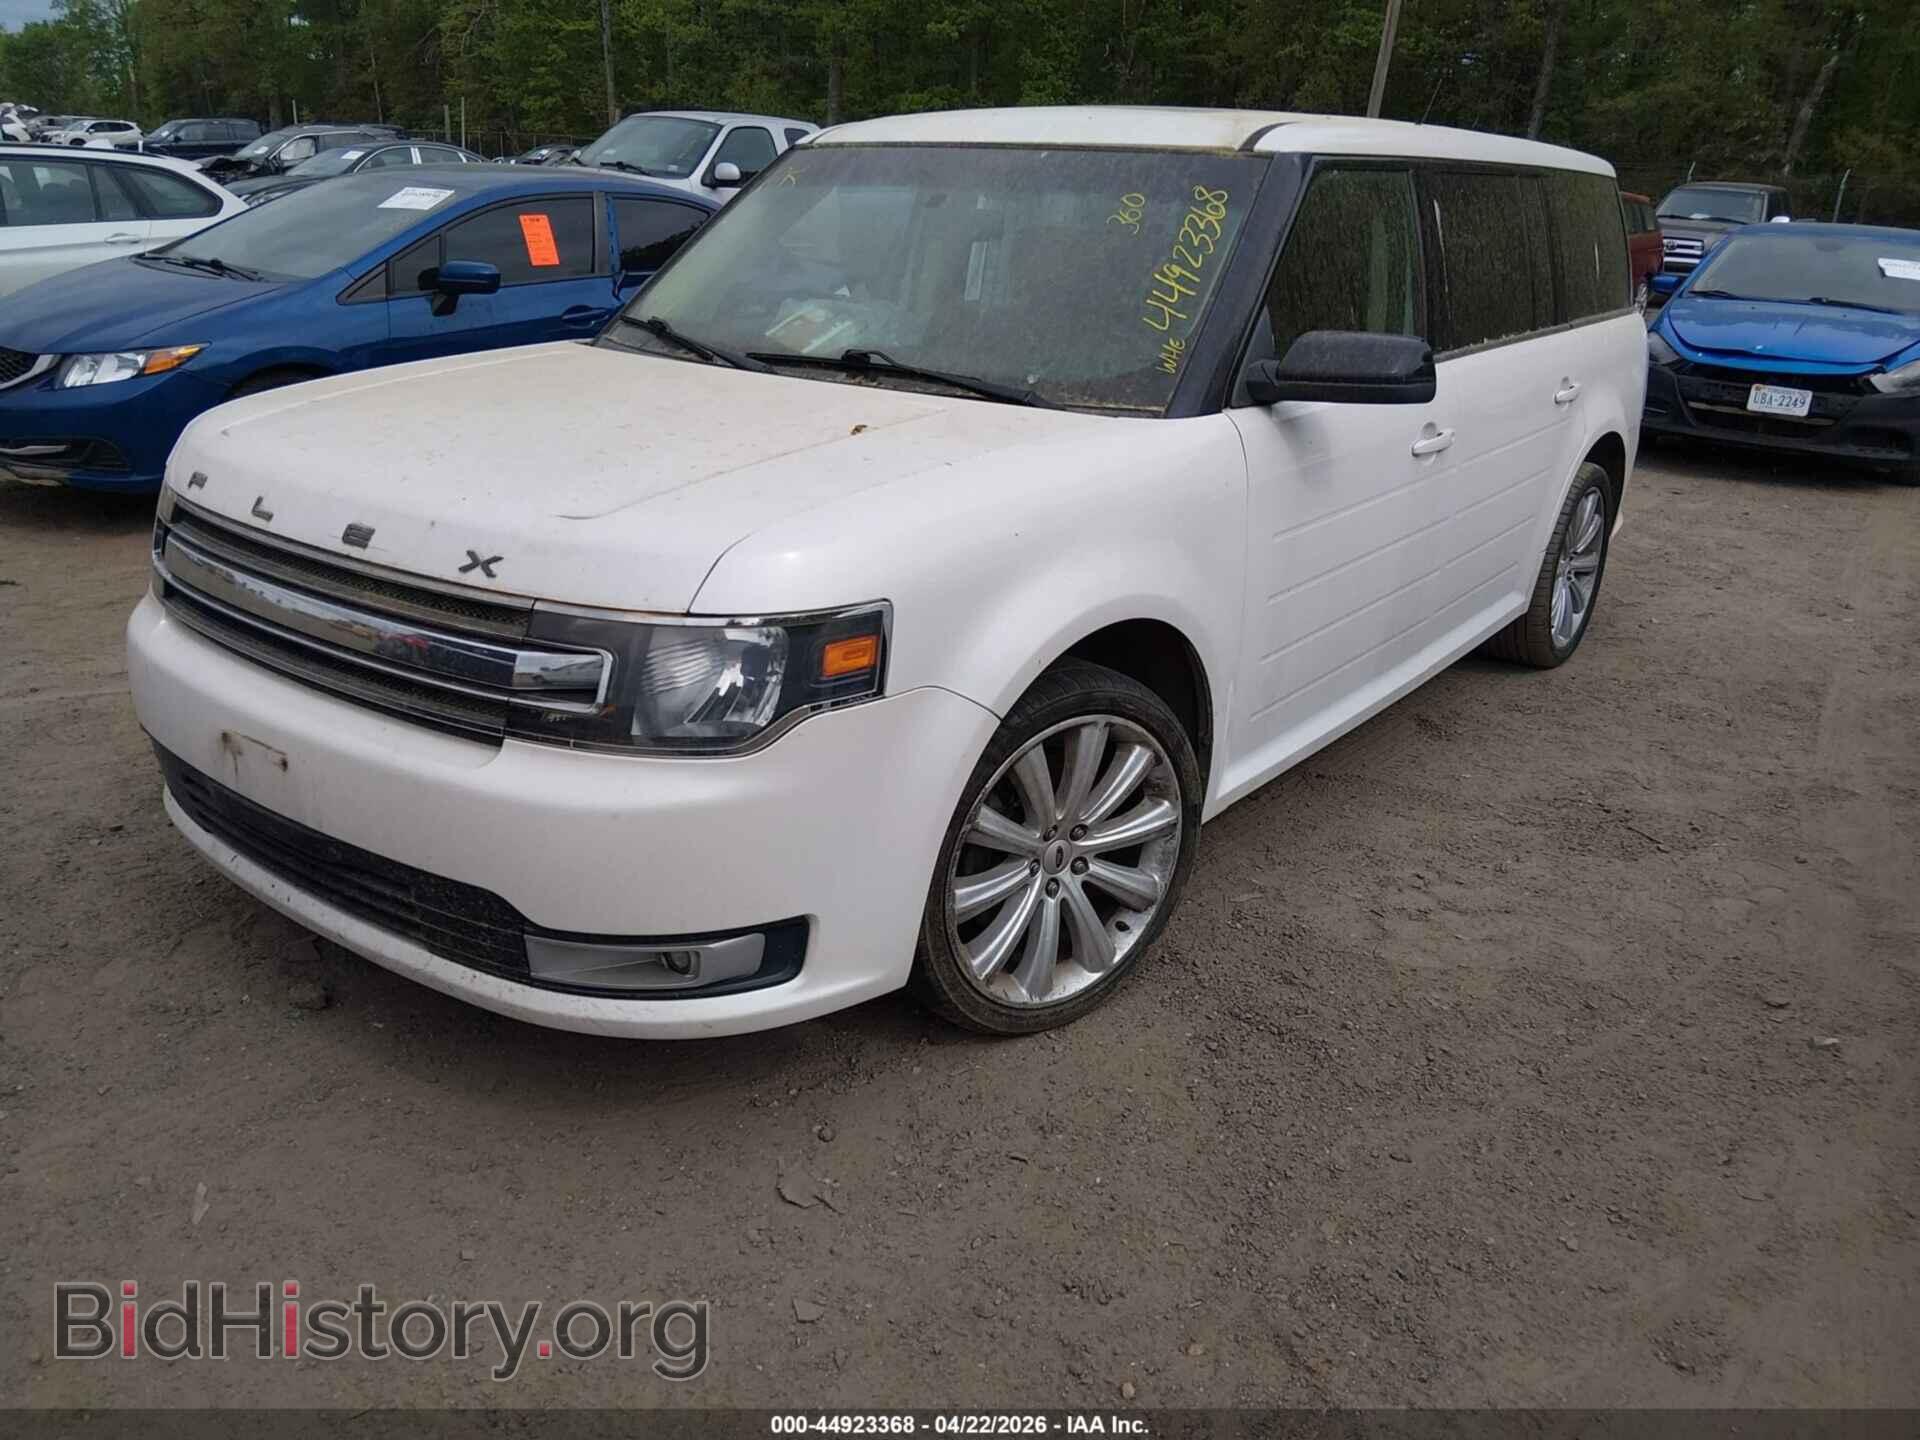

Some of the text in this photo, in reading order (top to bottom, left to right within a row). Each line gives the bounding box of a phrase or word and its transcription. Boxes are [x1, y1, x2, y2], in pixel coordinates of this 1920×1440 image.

[1106, 192, 1144, 234] 360
[1143, 185, 1228, 331] 44923368
[188, 470, 504, 578] FLEX
